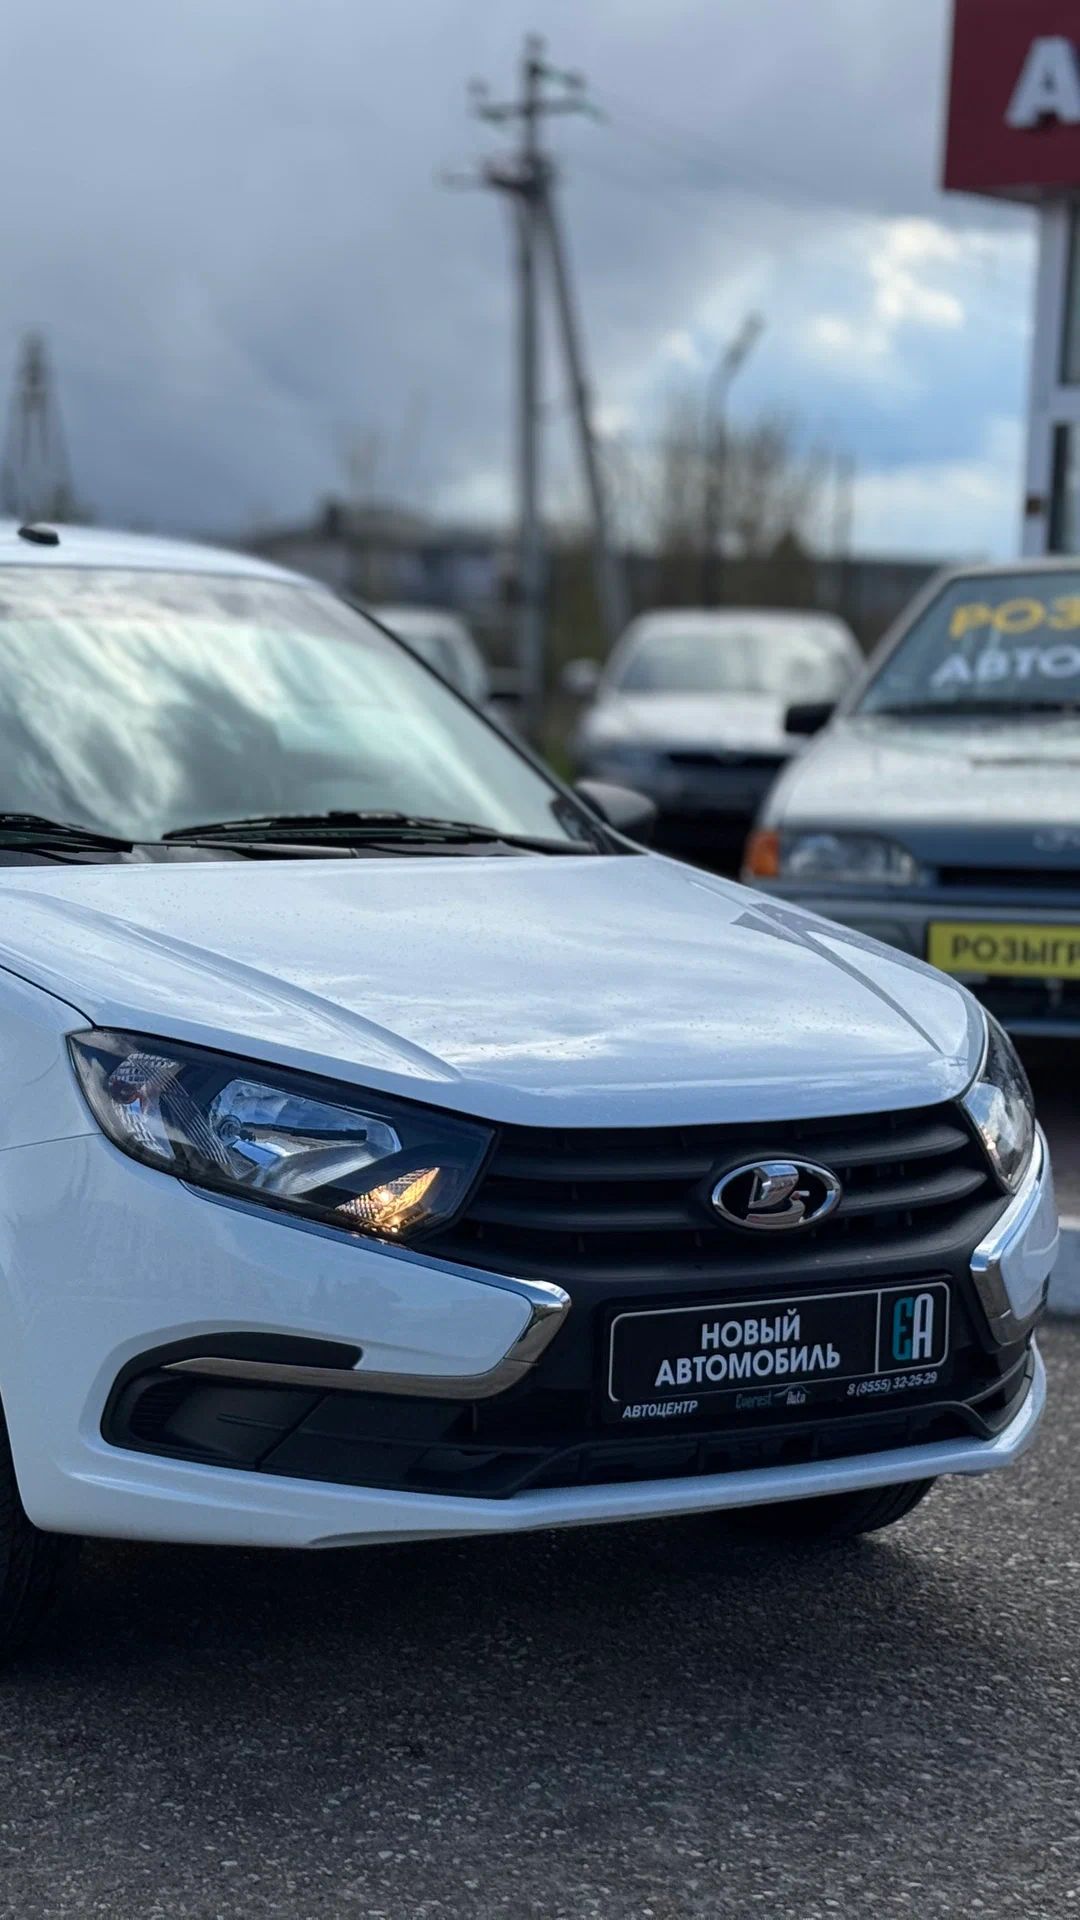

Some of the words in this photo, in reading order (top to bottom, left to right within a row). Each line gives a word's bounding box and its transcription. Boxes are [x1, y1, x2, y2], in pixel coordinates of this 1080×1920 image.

[929, 646, 1080, 688] АВТО
[701, 1308, 800, 1350] НОВЫЙ
[655, 1343, 840, 1387] АВТОМОБИЛЬ
[847, 1384, 856, 1396] 8
[856, 1378, 892, 1397] (8555)
[892, 1371, 938, 1389] 32-25-29
[622, 1400, 698, 1418] АВТОЦЕНТР
